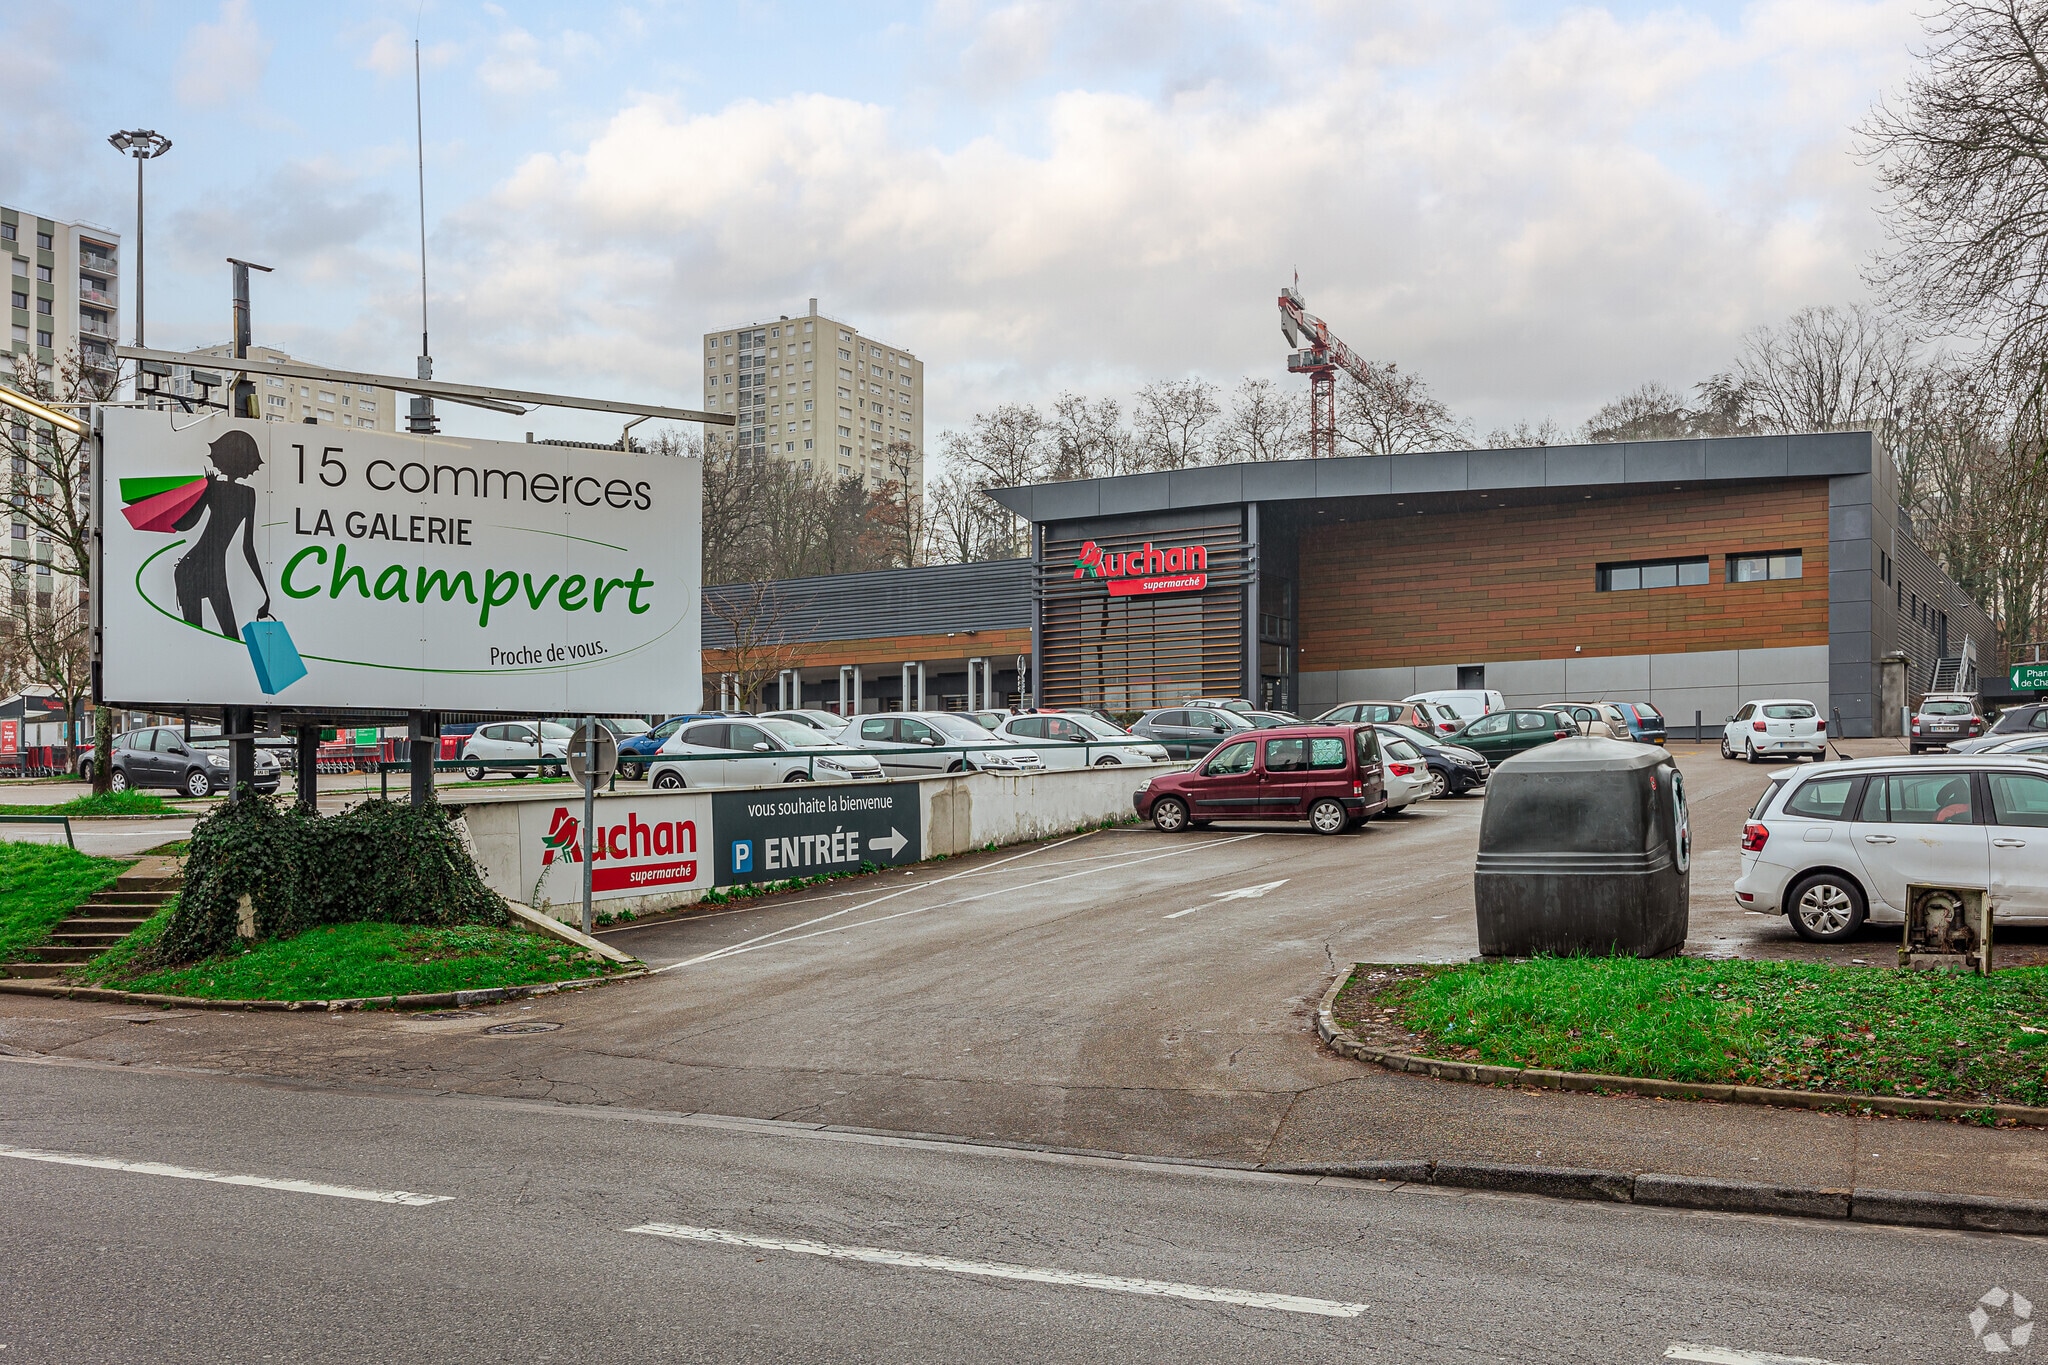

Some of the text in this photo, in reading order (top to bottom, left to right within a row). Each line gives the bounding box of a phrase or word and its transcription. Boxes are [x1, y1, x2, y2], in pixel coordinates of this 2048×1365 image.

[292, 444, 652, 510] 15 commerces
[296, 508, 472, 546] LA GALERIE
[1073, 541, 1207, 579] Auchan
[281, 543, 654, 628] Champvert
[1143, 575, 1200, 591] supermarché
[490, 640, 608, 666] Proche de vous.
[2021, 679, 2032, 687] de
[2026, 669, 2048, 678] Phar
[748, 795, 893, 817] vous souhaite la bienvenue
[765, 825, 860, 870] ENTRÉE
[630, 863, 691, 884] supermarché
